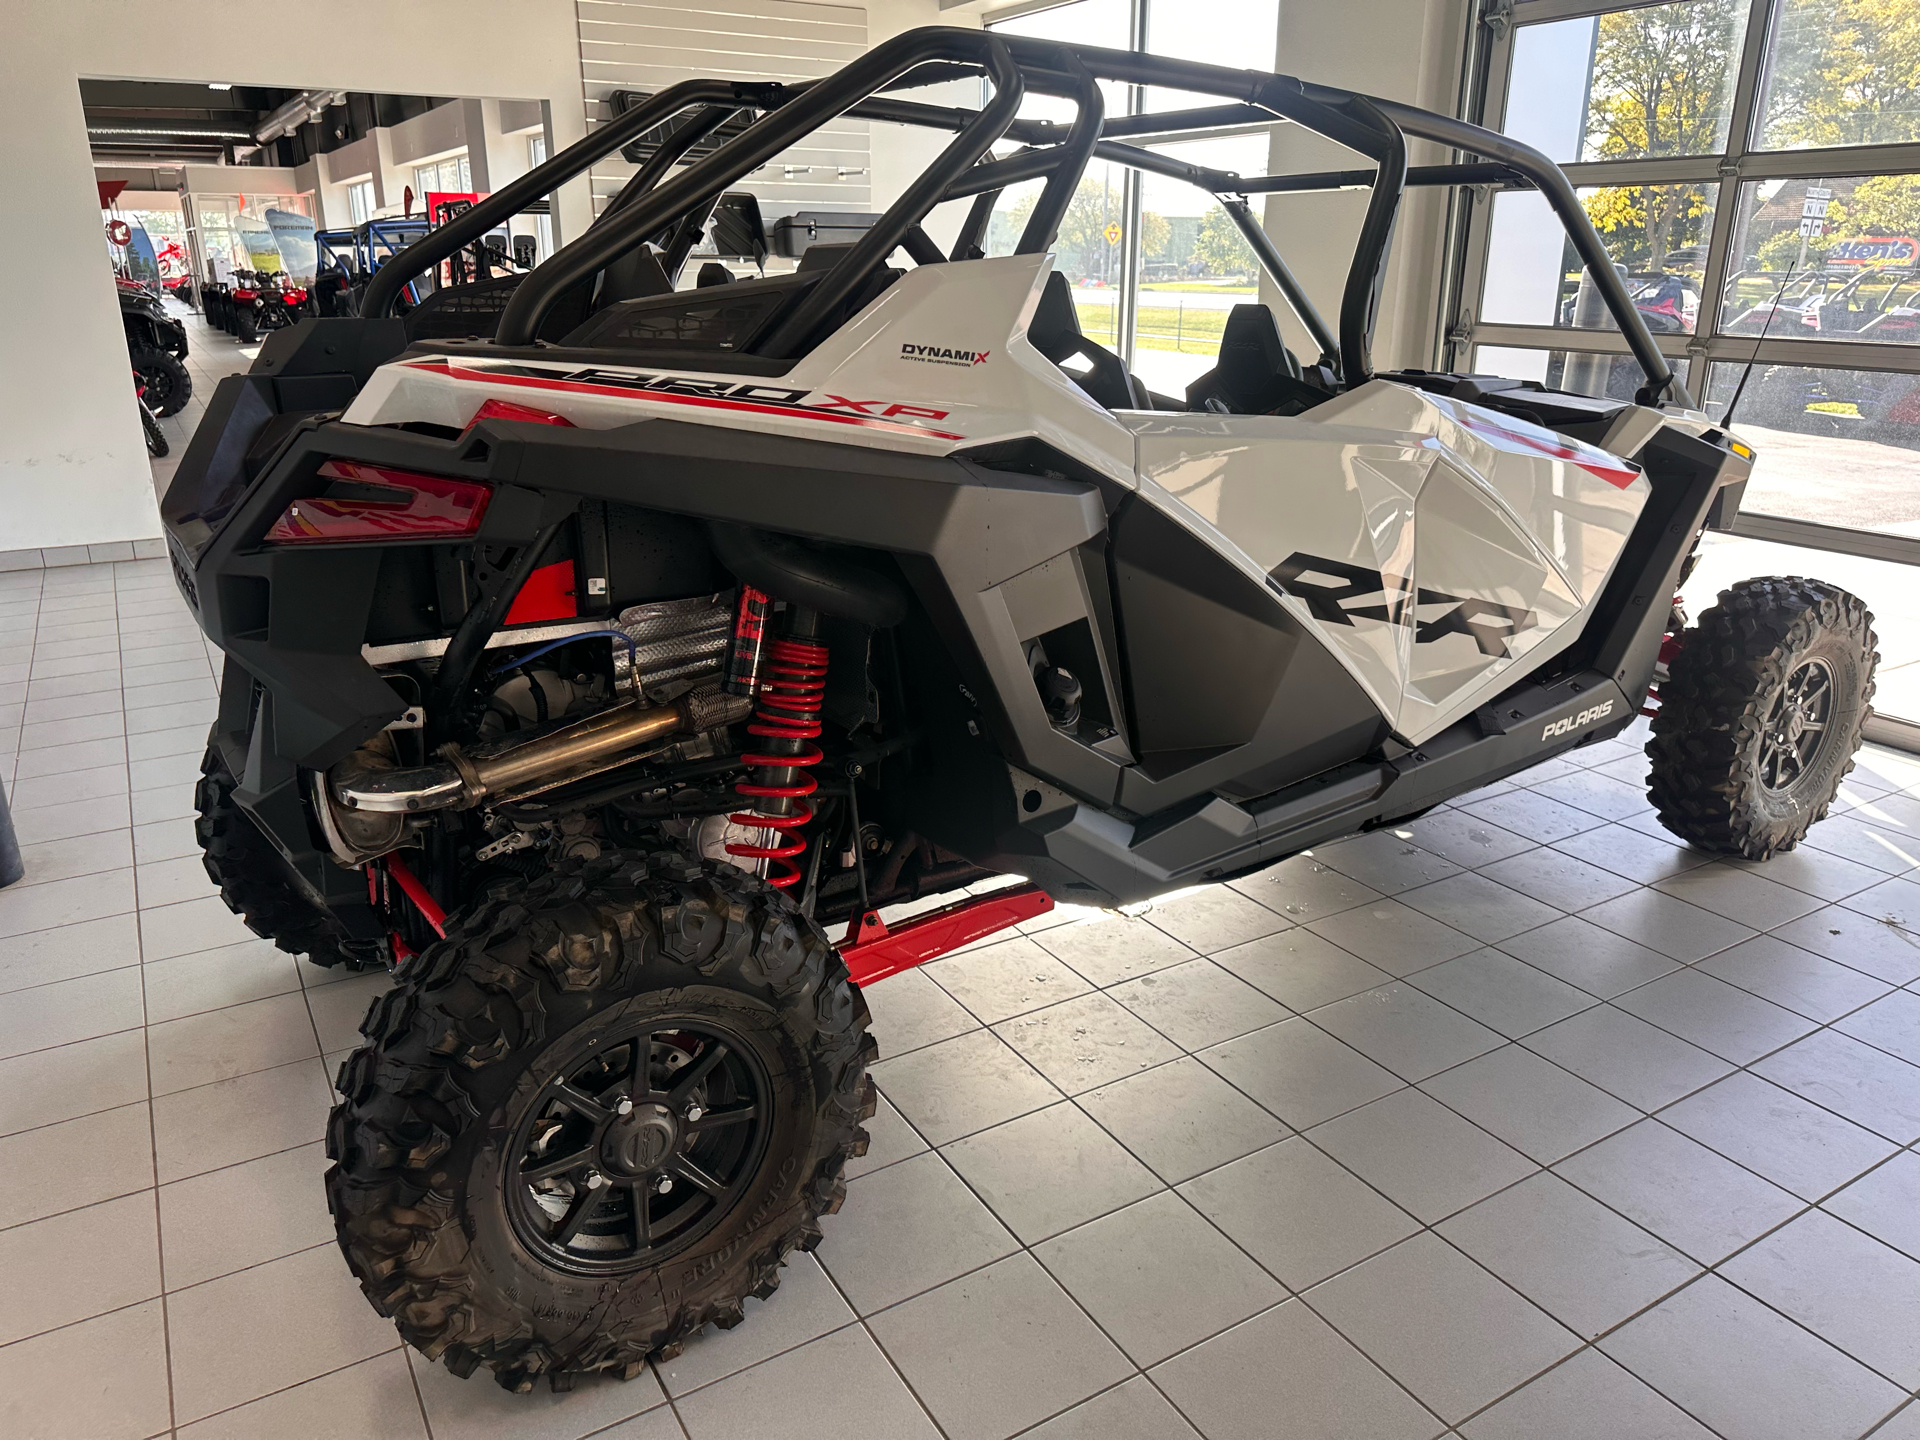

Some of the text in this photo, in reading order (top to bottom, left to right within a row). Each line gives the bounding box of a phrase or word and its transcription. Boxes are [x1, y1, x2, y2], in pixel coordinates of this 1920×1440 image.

[901, 343, 991, 366] DYNAMIX
[927, 358, 971, 367] SUSPENSION
[566, 367, 952, 421] PRO XP
[1265, 551, 1539, 660] RZR
[1541, 699, 1614, 742] POLARIS
